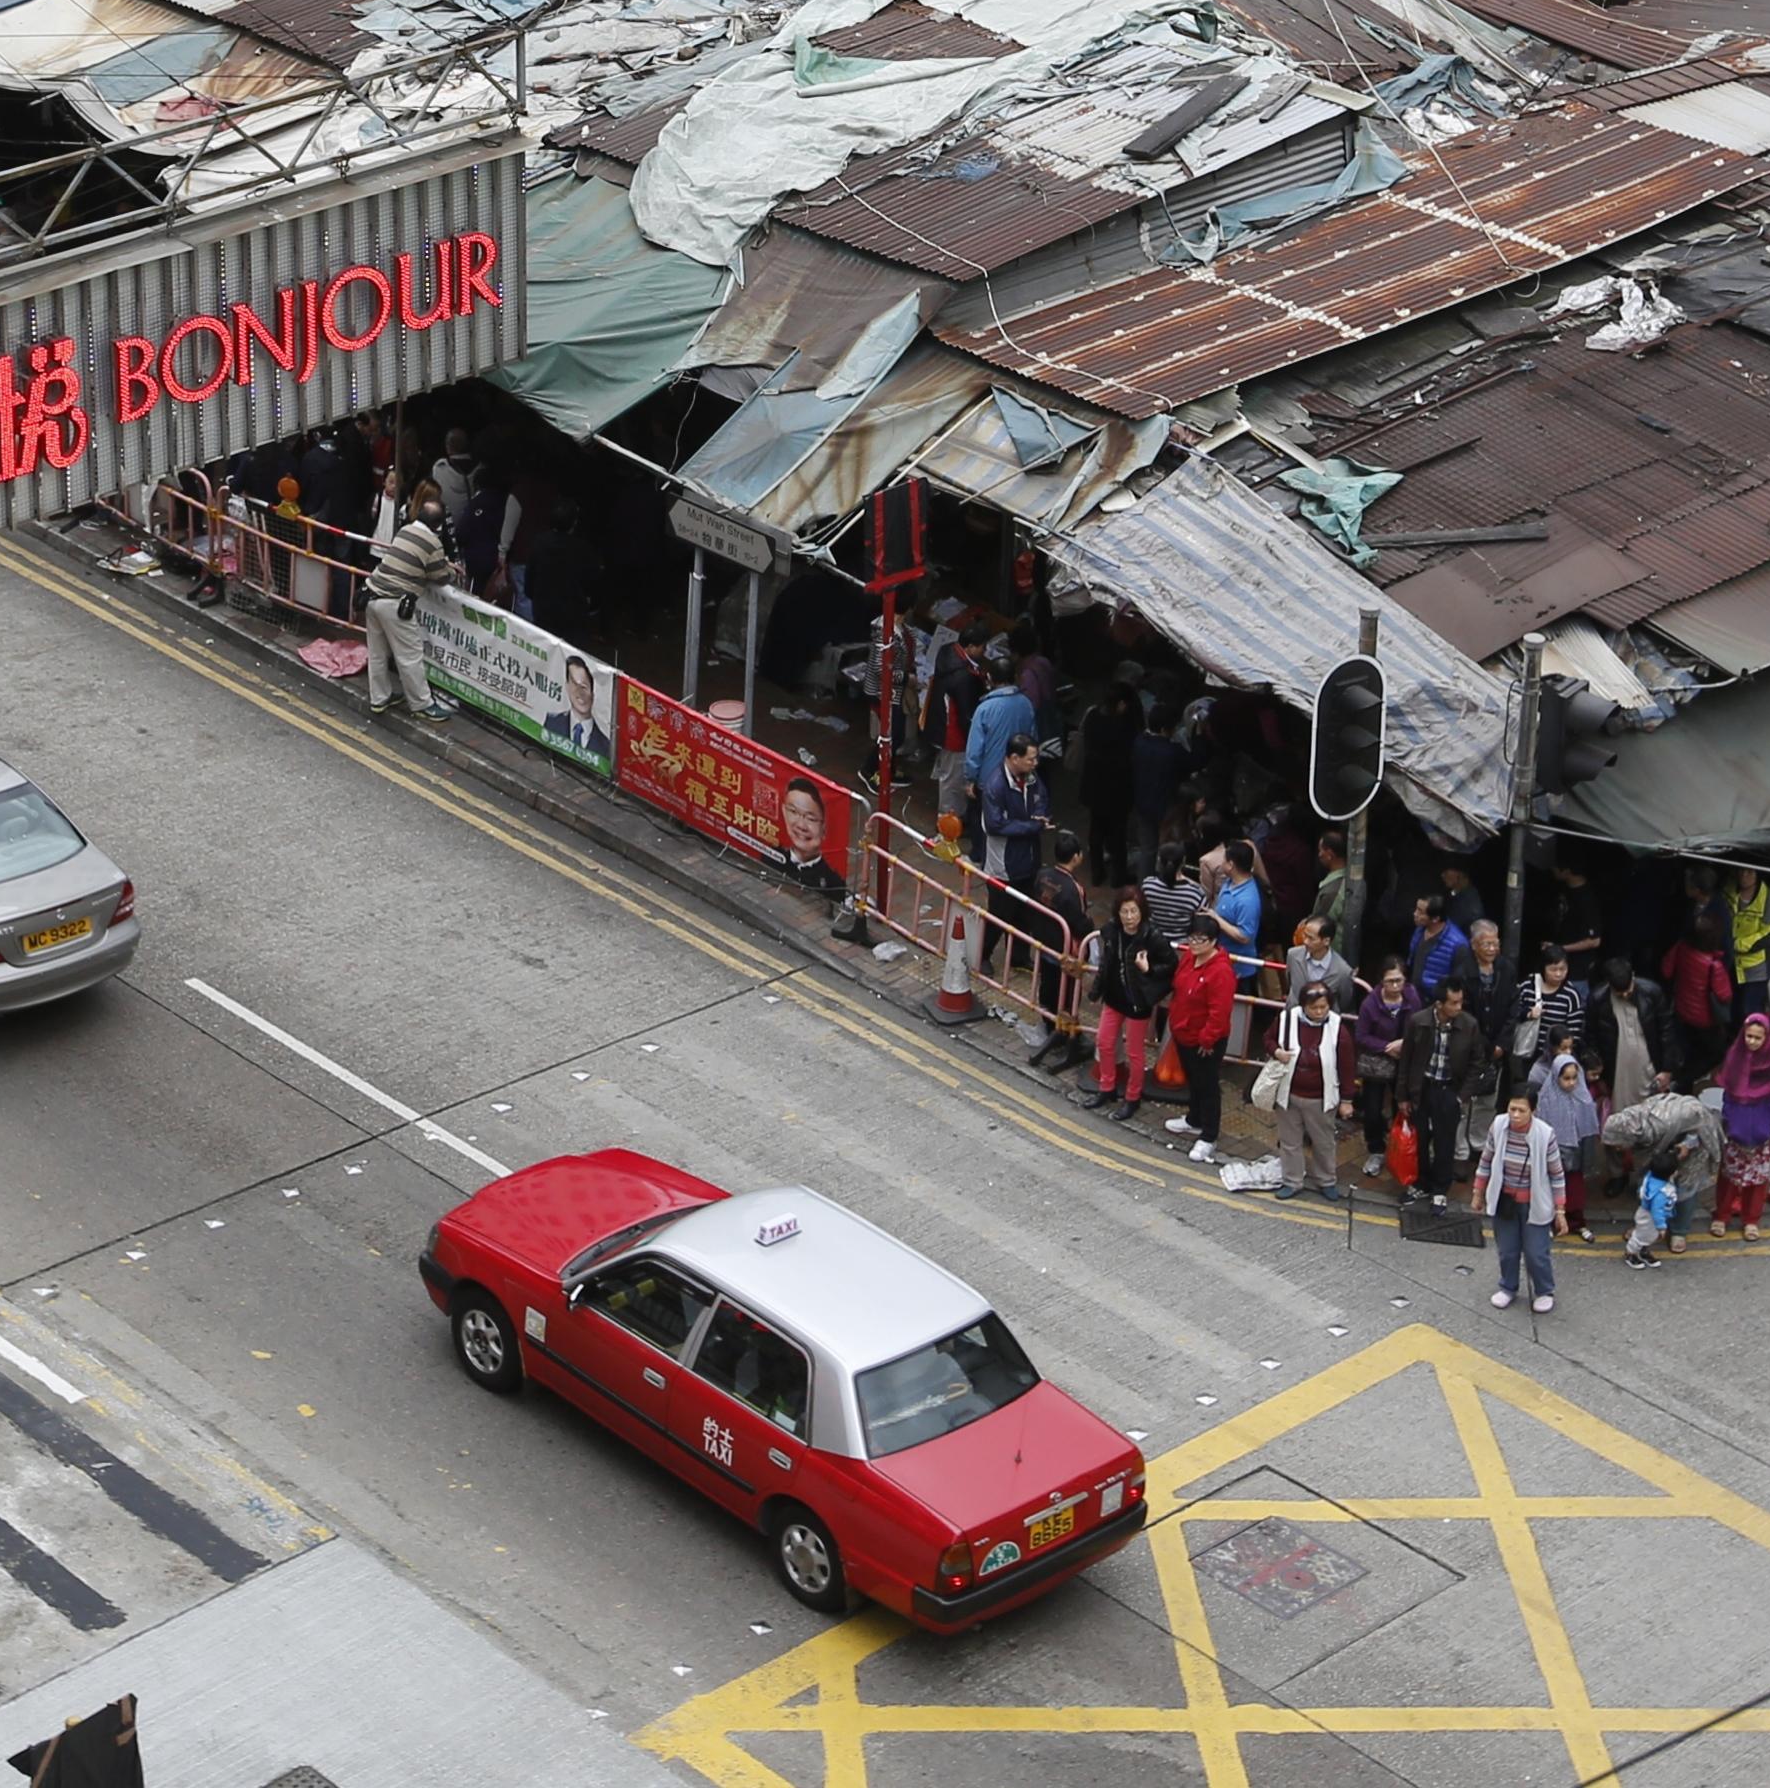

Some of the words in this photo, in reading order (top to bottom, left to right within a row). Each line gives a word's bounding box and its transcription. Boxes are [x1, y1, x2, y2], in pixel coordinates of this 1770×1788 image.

[114, 231, 503, 424] BONJOUR
[726, 525, 755, 545] Street
[684, 777, 780, 847] 福至財臨
[49, 919, 88, 943] 9322
[769, 1218, 797, 1239] TAXI
[703, 1416, 734, 1448] 的士
[702, 1432, 732, 1466] TAXI
